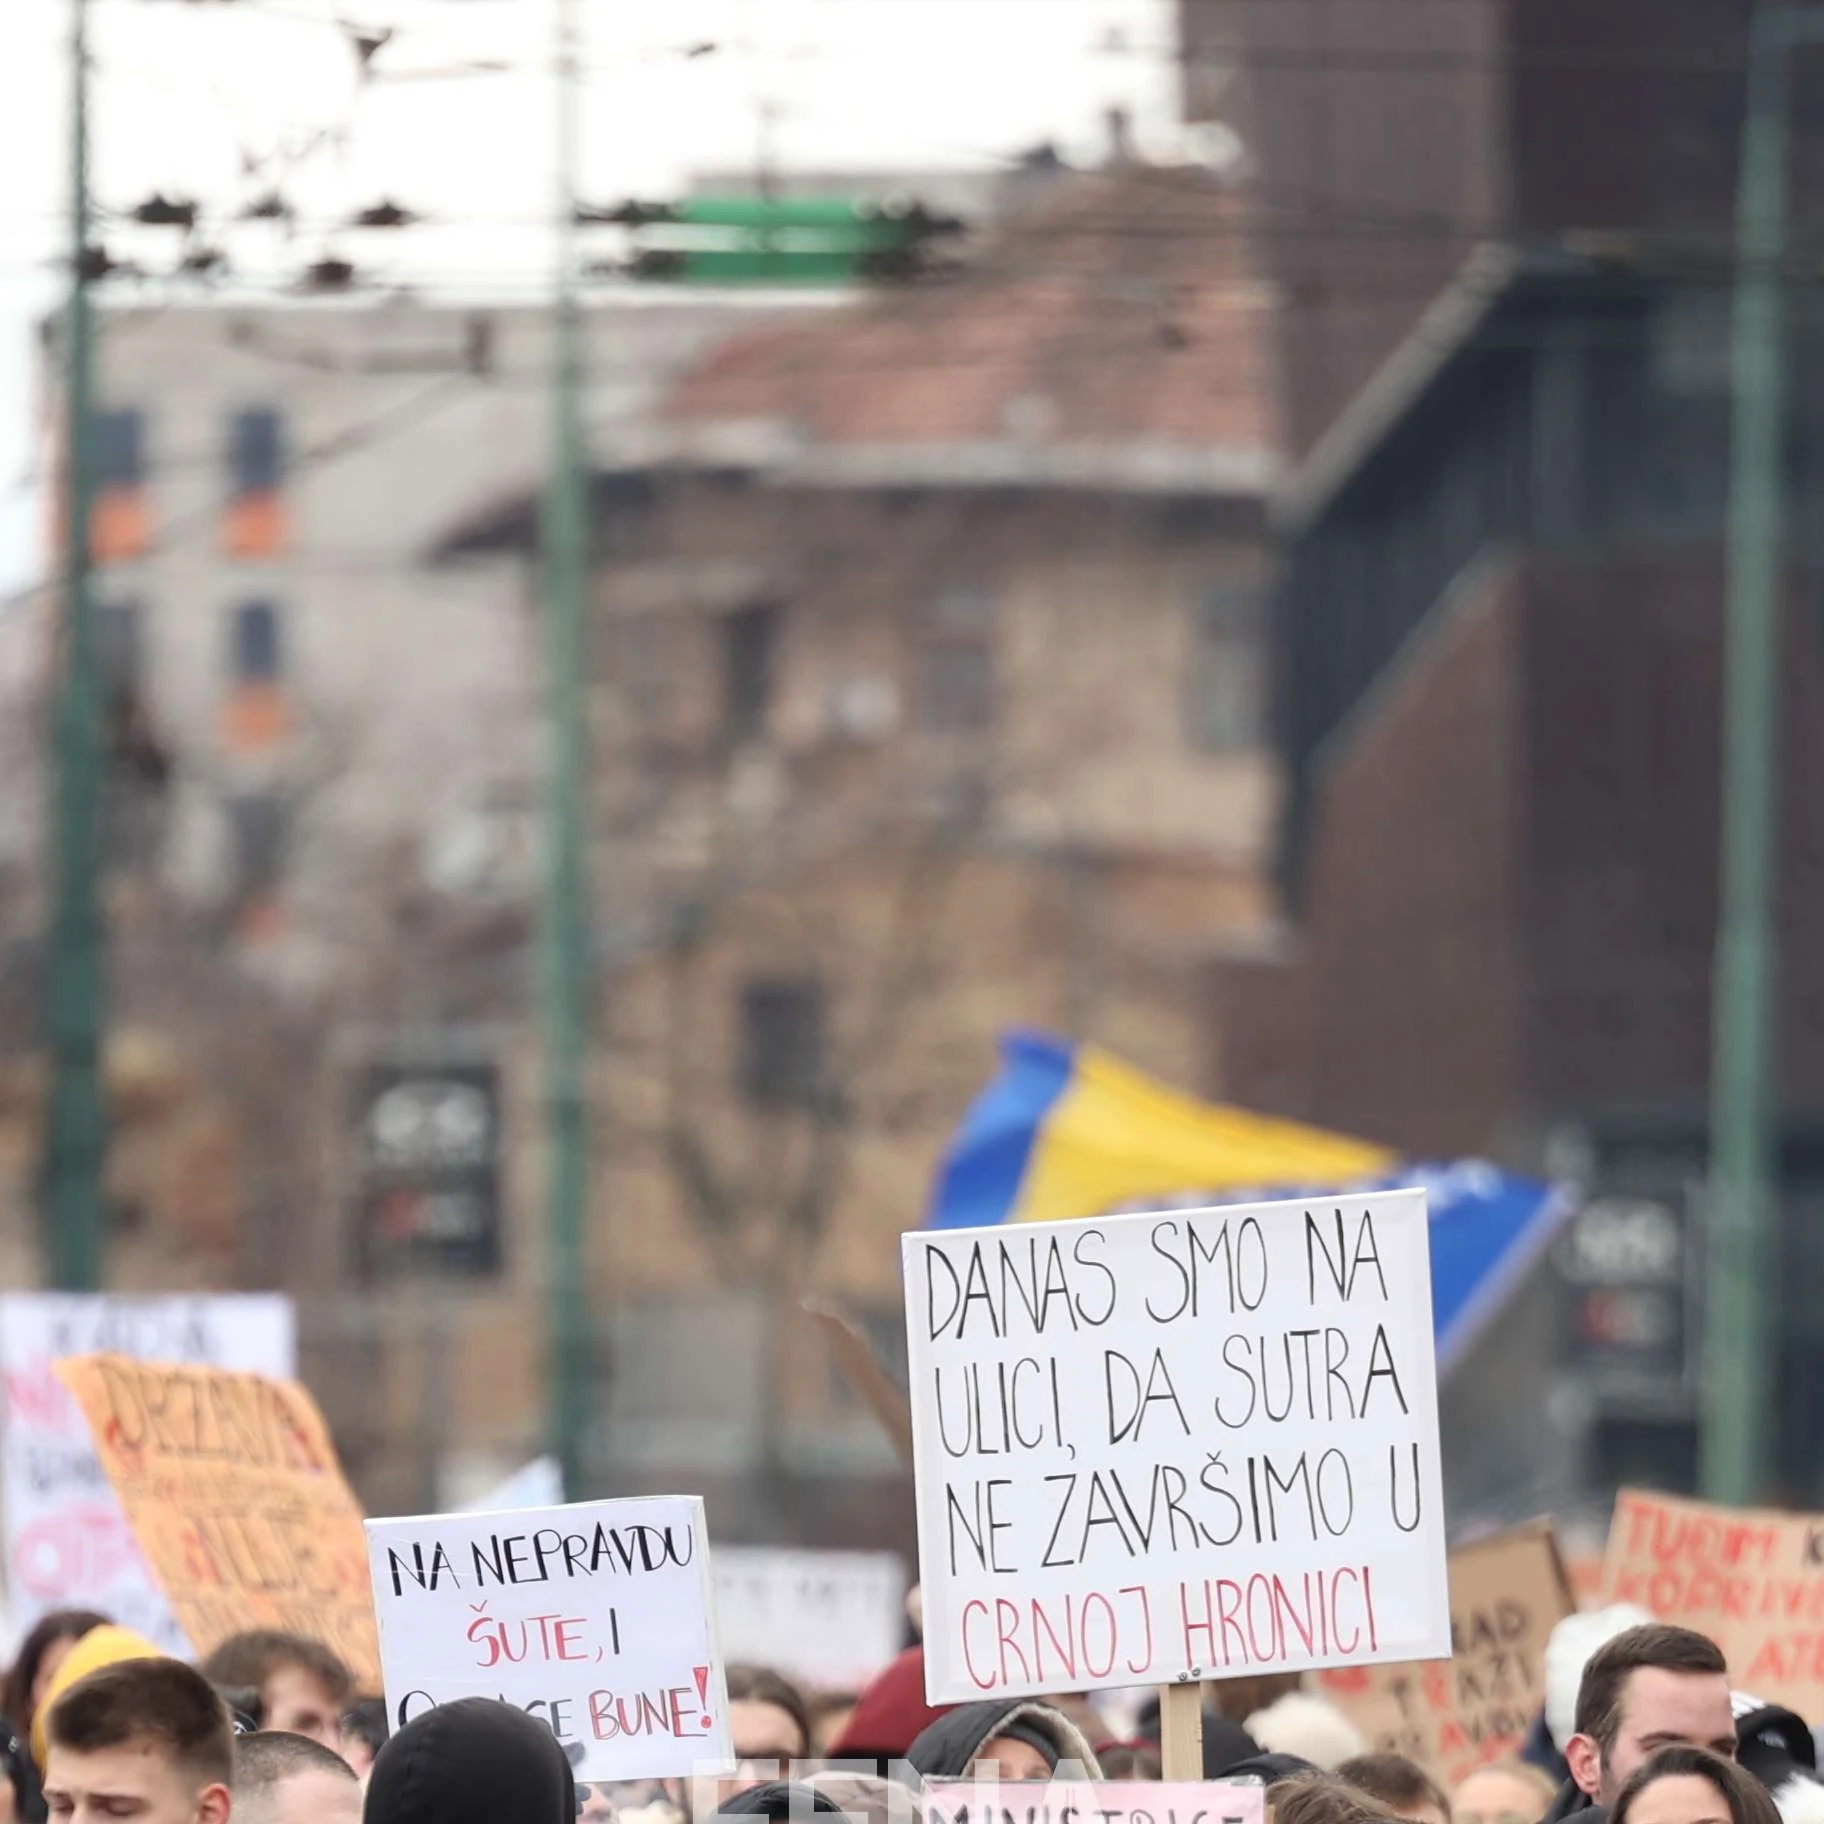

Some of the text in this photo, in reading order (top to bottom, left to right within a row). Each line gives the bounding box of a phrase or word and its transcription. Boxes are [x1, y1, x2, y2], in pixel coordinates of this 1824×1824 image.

[926, 1207, 1389, 1342] DANAS SMO NA
[934, 1323, 1409, 1461] ULICI, DA SUTRA
[387, 1540, 461, 1597] NA
[470, 1520, 693, 1588] NEPRAVDU
[946, 1442, 1421, 1577] NE ZAVRŠIMO U
[466, 1599, 621, 1668] ŠUTE, I
[961, 1584, 1153, 1691] CRNOJ
[1179, 1563, 1378, 1670] HRONICI
[588, 1666, 713, 1740] BUNE!
